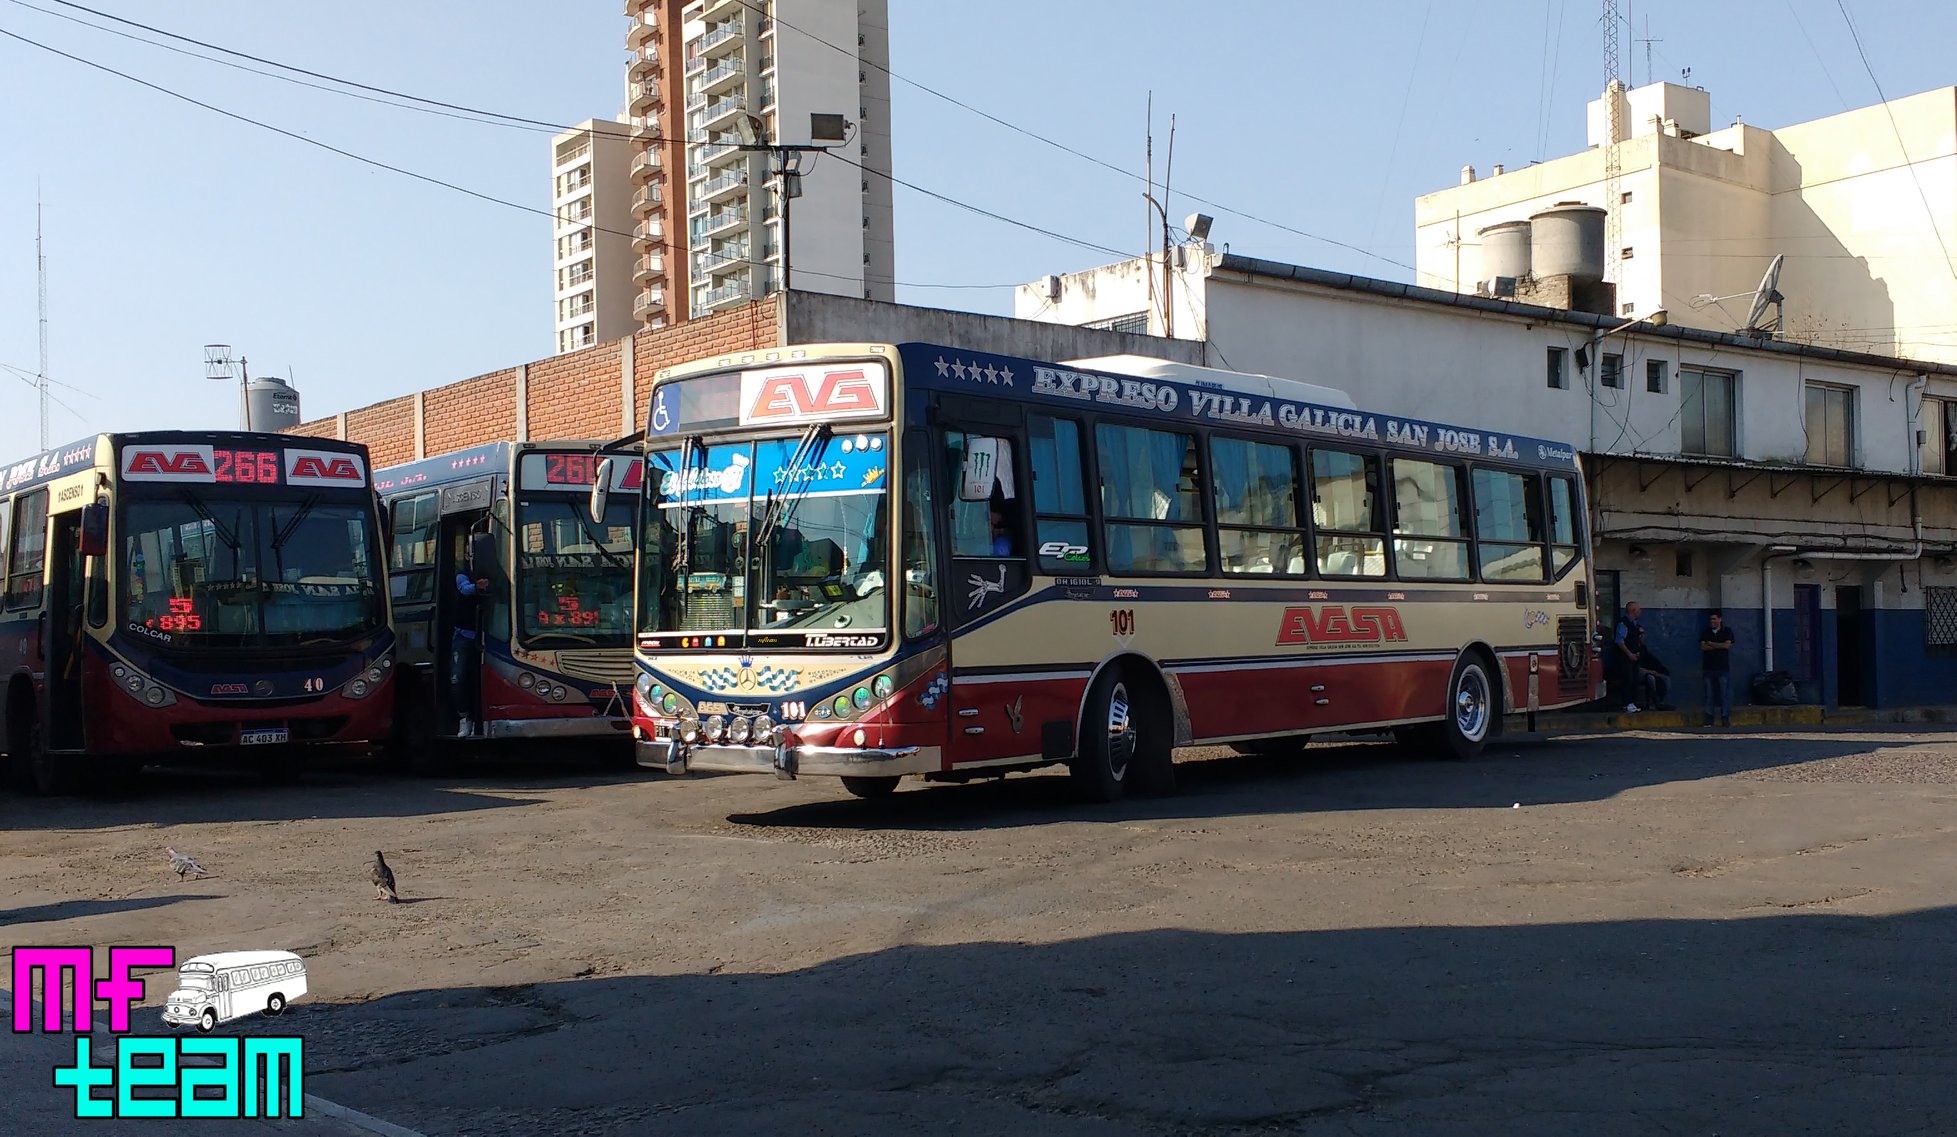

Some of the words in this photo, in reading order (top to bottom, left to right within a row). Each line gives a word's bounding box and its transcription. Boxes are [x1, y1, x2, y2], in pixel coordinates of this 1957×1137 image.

[746, 369, 880, 420] EVG
[1032, 365, 1178, 412] EXPRESO
[1188, 389, 1275, 426] VILLA
[1278, 404, 1378, 440] GALICIA
[1386, 420, 1428, 448] SAN
[1434, 428, 1481, 454] JOSE
[125, 451, 212, 474] EVG
[213, 450, 278, 484] 266
[288, 456, 363, 480] EVG
[168, 598, 193, 613] 5
[128, 623, 172, 642] COLCAR
[159, 615, 202, 630] 895
[1110, 609, 1135, 635] 101
[1275, 606, 1408, 646] EVGSA
[303, 678, 324, 692] 40
[781, 701, 806, 720] 101
[256, 734, 273, 743] 403
